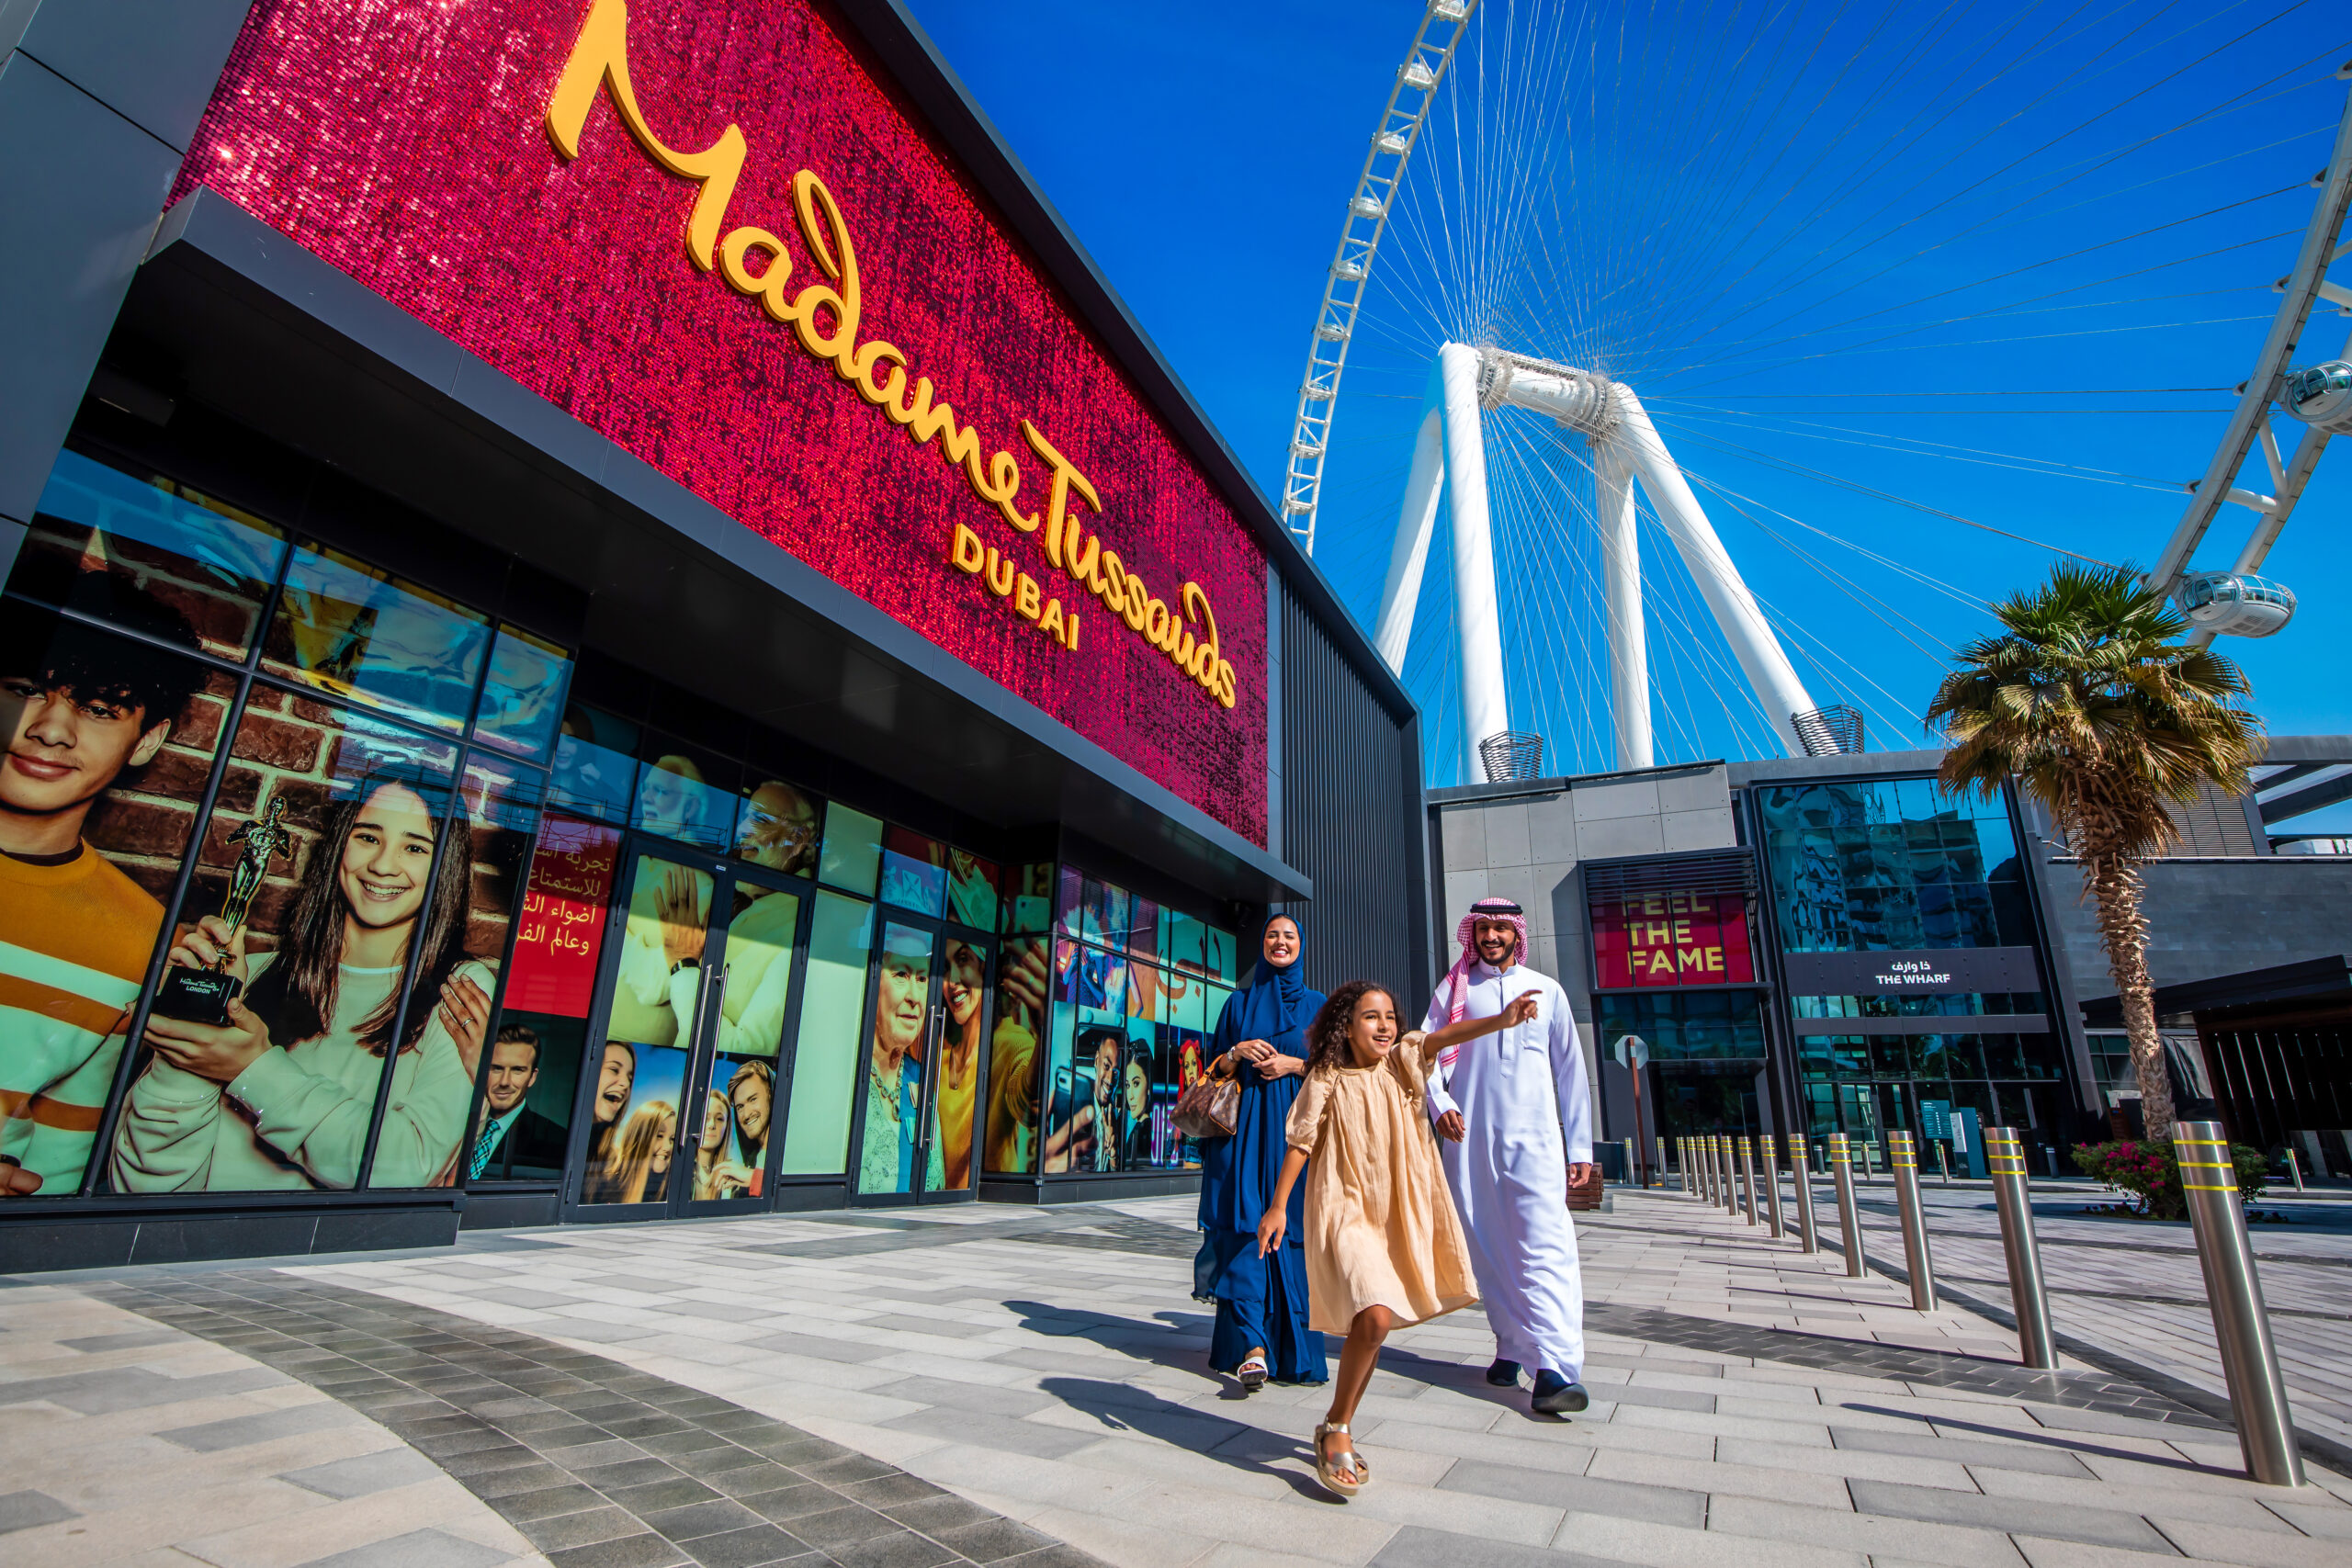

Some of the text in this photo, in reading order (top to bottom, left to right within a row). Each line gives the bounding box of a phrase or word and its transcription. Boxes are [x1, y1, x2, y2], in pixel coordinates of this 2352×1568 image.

[545, 0, 1237, 710] Madame Tussauds
[952, 523, 1080, 651] DUBAI
[565, 844, 611, 873] تجربة
[551, 900, 598, 925] أضواء
[1621, 890, 1711, 917] FEEL
[550, 926, 590, 956] وعالم
[1623, 919, 1693, 946] THE
[1627, 946, 1724, 975] FAME
[1892, 961, 1931, 974] ذا وارف
[186, 986, 211, 994] LONDON
[1875, 974, 1951, 985] THE WHARF
